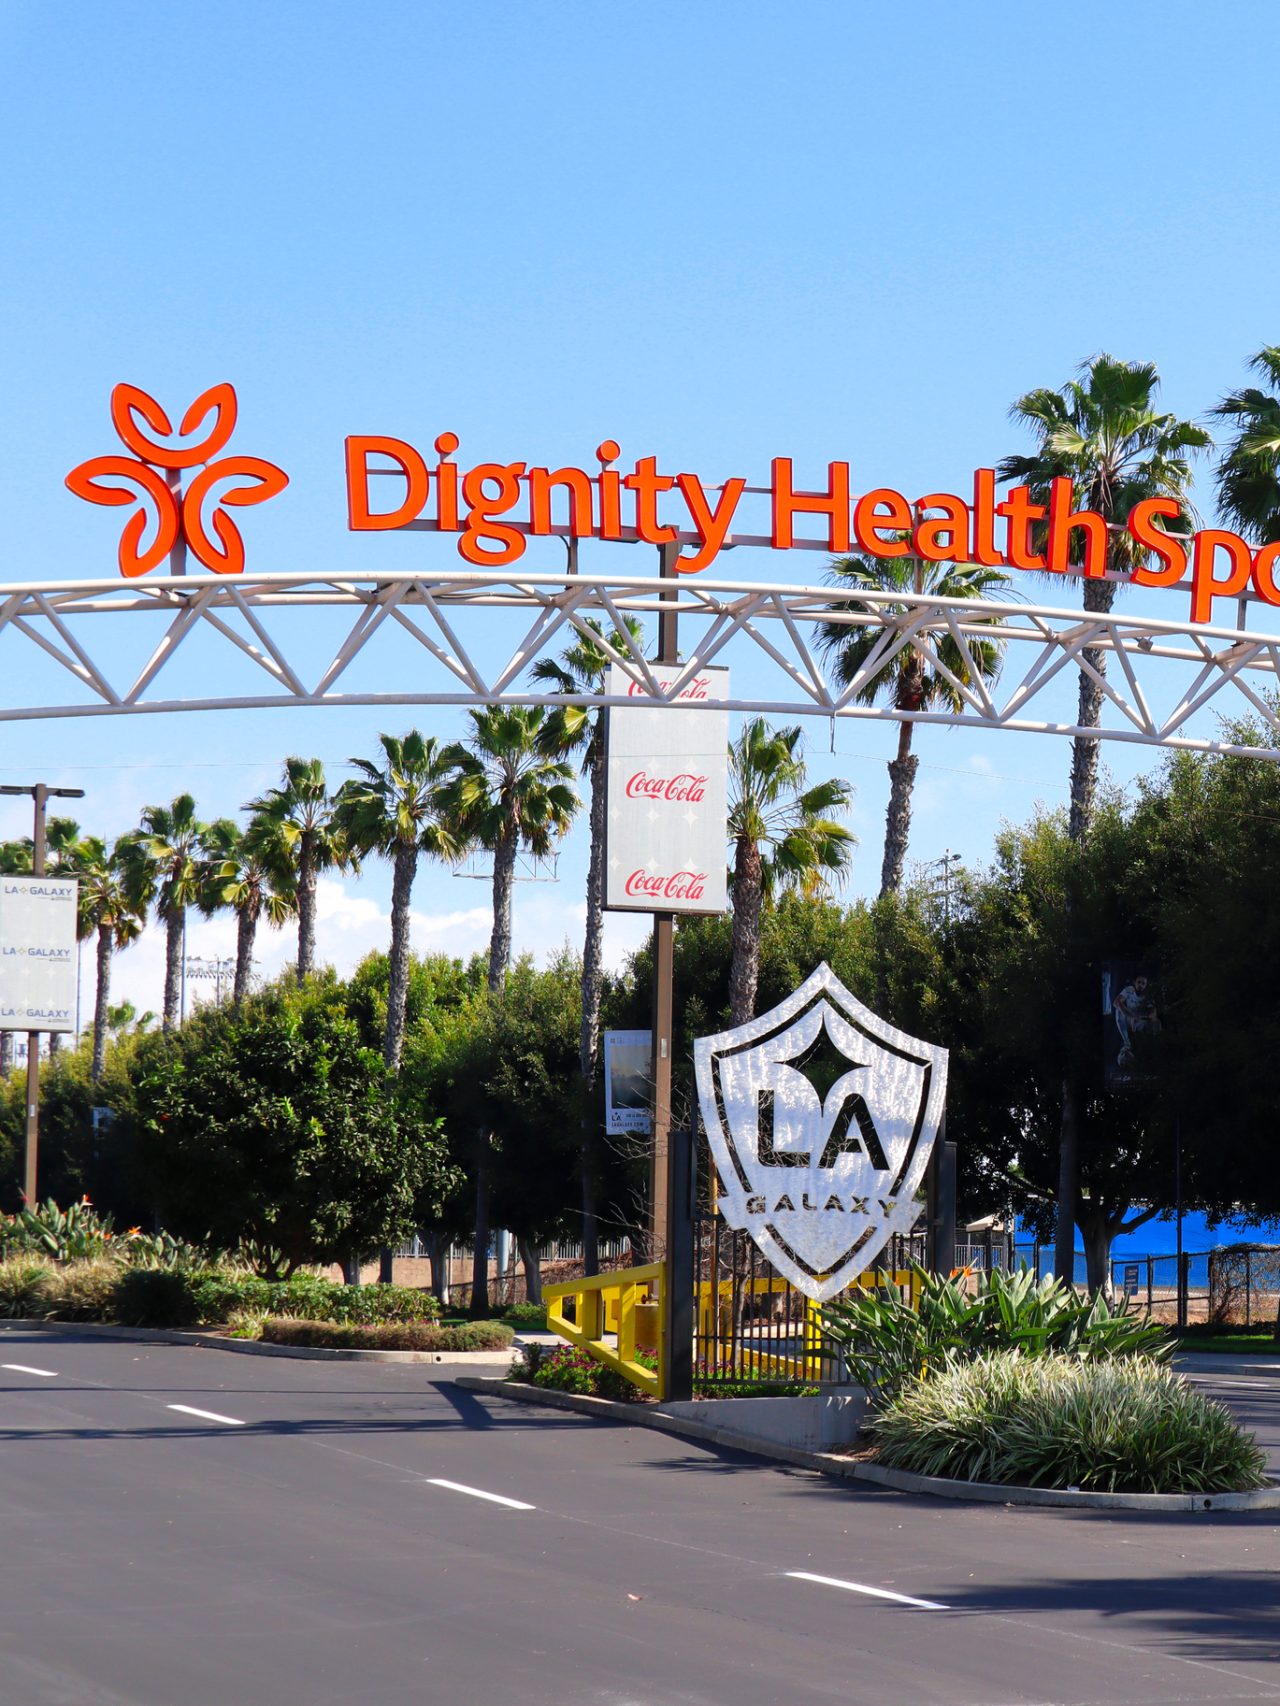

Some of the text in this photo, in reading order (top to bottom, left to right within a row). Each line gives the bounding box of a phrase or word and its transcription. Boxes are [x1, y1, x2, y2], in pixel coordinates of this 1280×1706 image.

[345, 432, 746, 574] Dignity
[771, 457, 1109, 580] Health
[625, 771, 710, 802] Coca-Cola
[5, 885, 72, 896] LA GALAXY
[625, 869, 710, 900] Coca-Cola
[2, 947, 71, 957] LA GALAXY
[1, 1008, 69, 1018] LA GALAXY
[757, 1089, 890, 1171] LA
[746, 1193, 897, 1218] GALAXY
